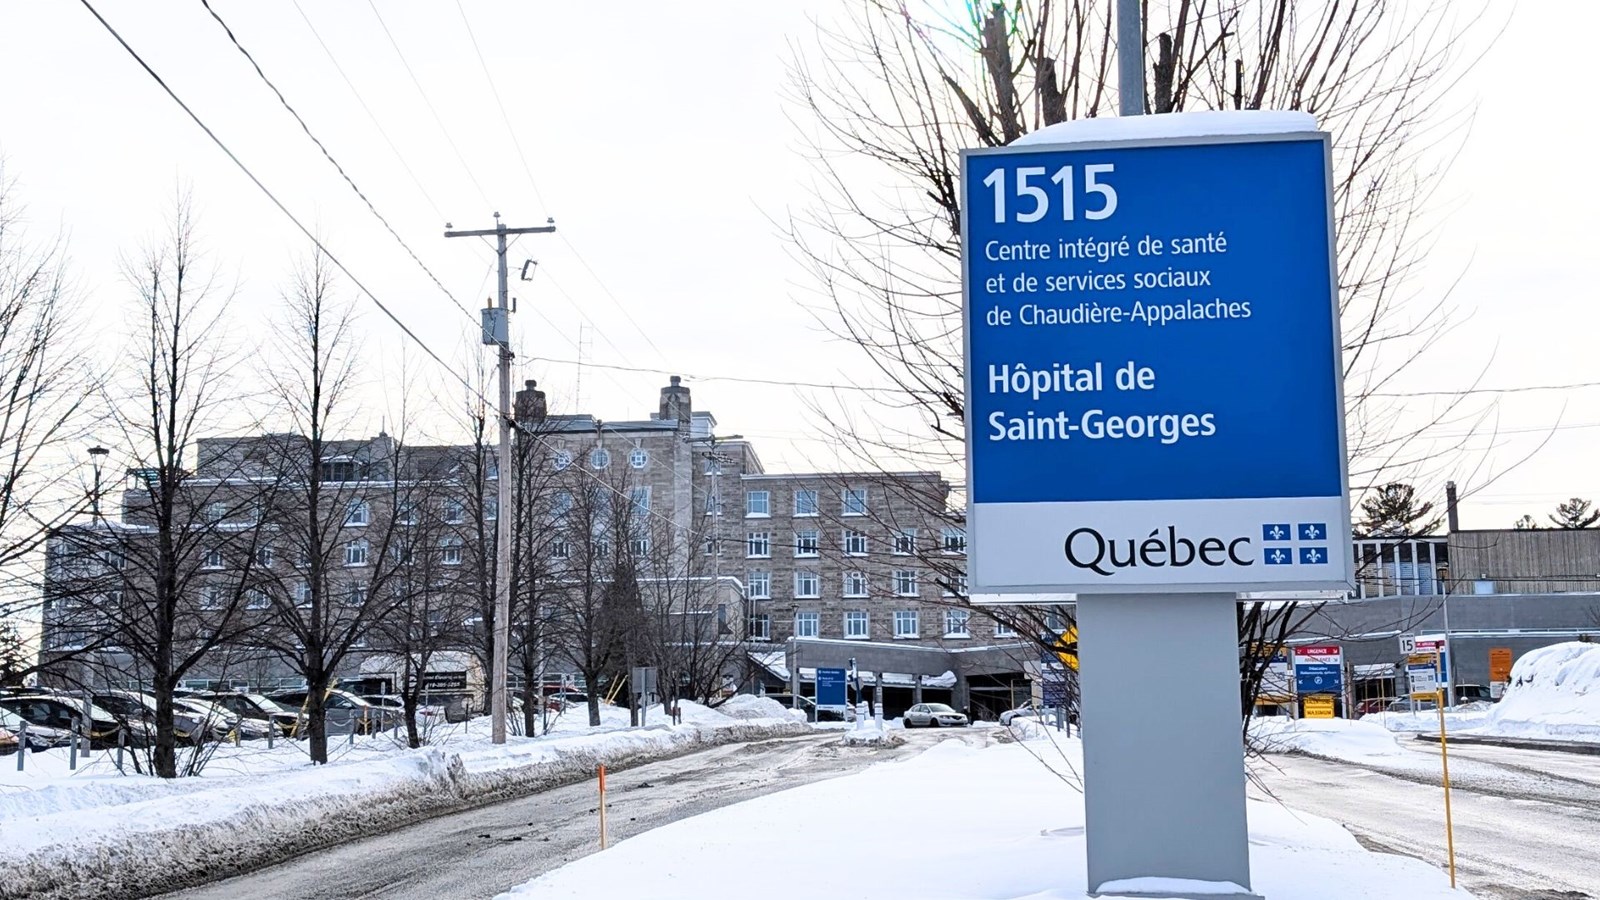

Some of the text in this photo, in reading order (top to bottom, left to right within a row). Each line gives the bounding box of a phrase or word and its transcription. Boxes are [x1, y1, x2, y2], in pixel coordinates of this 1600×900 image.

[983, 163, 1118, 223] 1515
[985, 231, 1227, 263] Centre intégré de santé
[986, 267, 1211, 293] et de services sociaux
[986, 298, 1252, 326] de Chaudière-Appalaches
[989, 361, 1156, 400] Hôpital de
[988, 410, 1216, 444] Saint-Georges
[1064, 525, 1255, 577] Québec
[1402, 640, 1414, 652] 15
